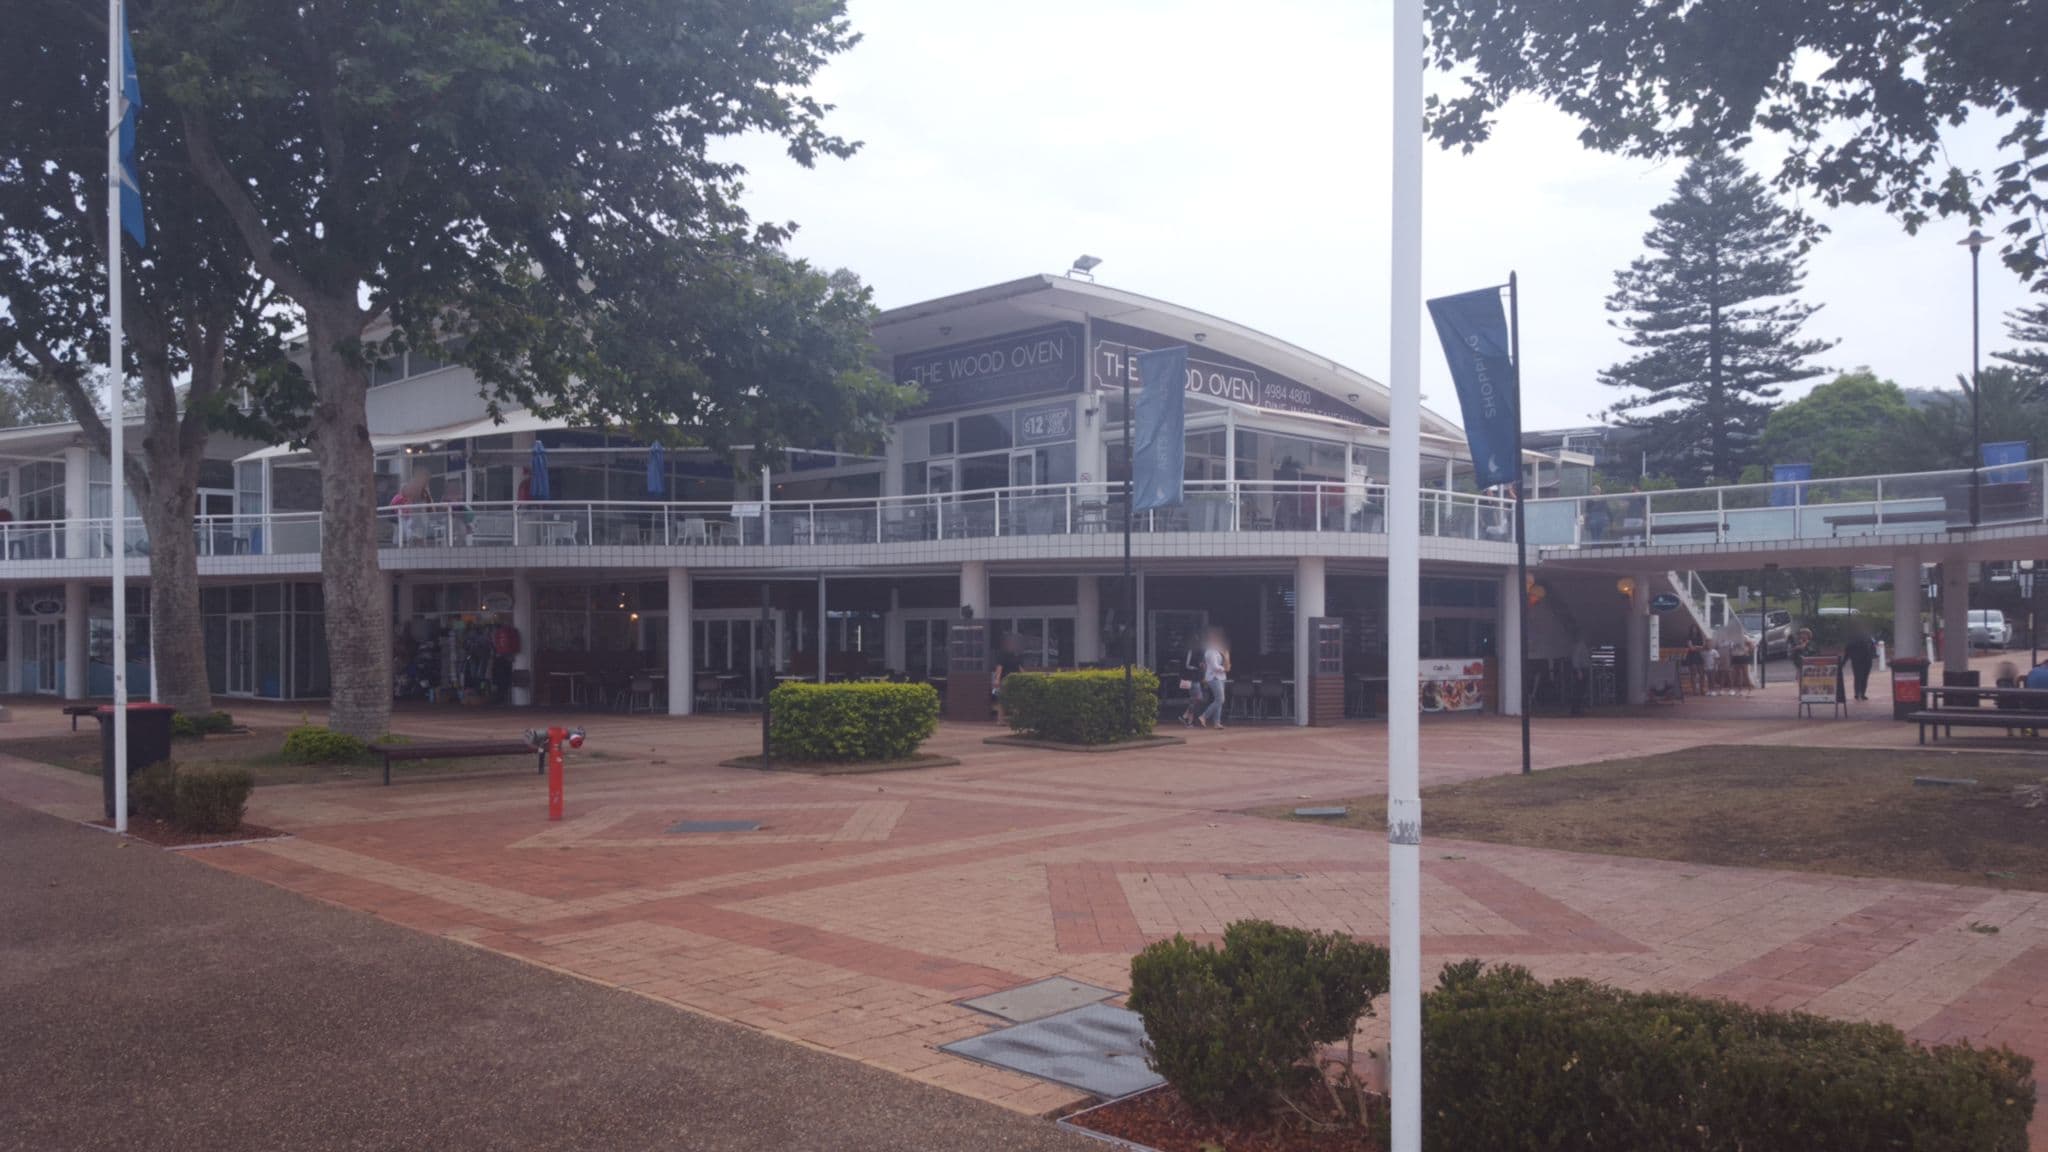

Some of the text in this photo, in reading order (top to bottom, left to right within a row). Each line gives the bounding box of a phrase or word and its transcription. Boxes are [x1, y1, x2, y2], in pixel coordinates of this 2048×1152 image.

[912, 337, 1064, 384] THE WOOD OVEN
[1103, 351, 1139, 382] THE
[1208, 372, 1254, 402] OVEN
[1264, 383, 1287, 400] 4984
[1024, 415, 1044, 434] $12
